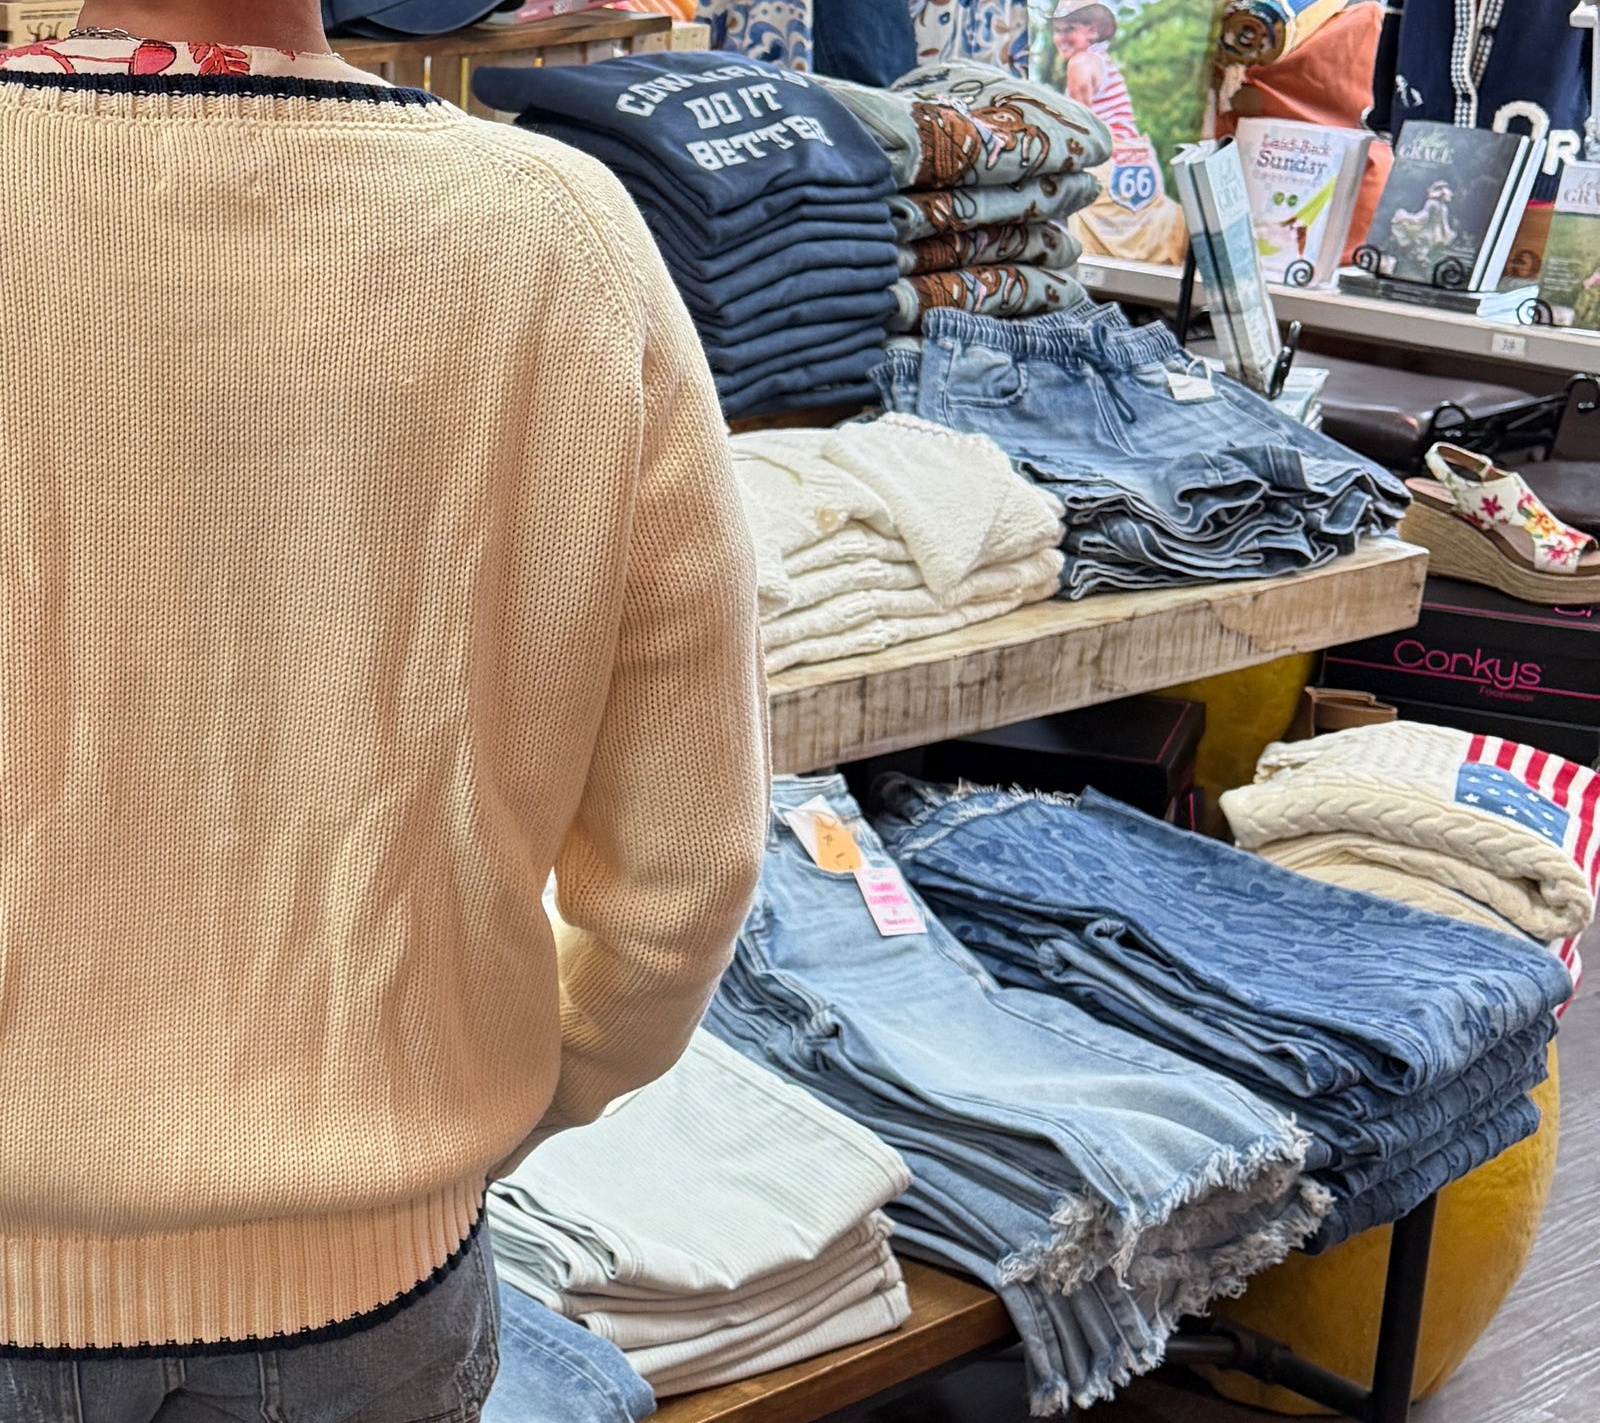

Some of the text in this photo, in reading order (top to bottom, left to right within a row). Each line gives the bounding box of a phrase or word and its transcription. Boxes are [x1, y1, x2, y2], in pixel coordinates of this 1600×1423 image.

[683, 82, 784, 129] DO IT
[686, 114, 835, 171] BETTER
[1257, 150, 1329, 178] Sunday
[1118, 166, 1153, 198] 66
[1393, 639, 1545, 691] Corkys
